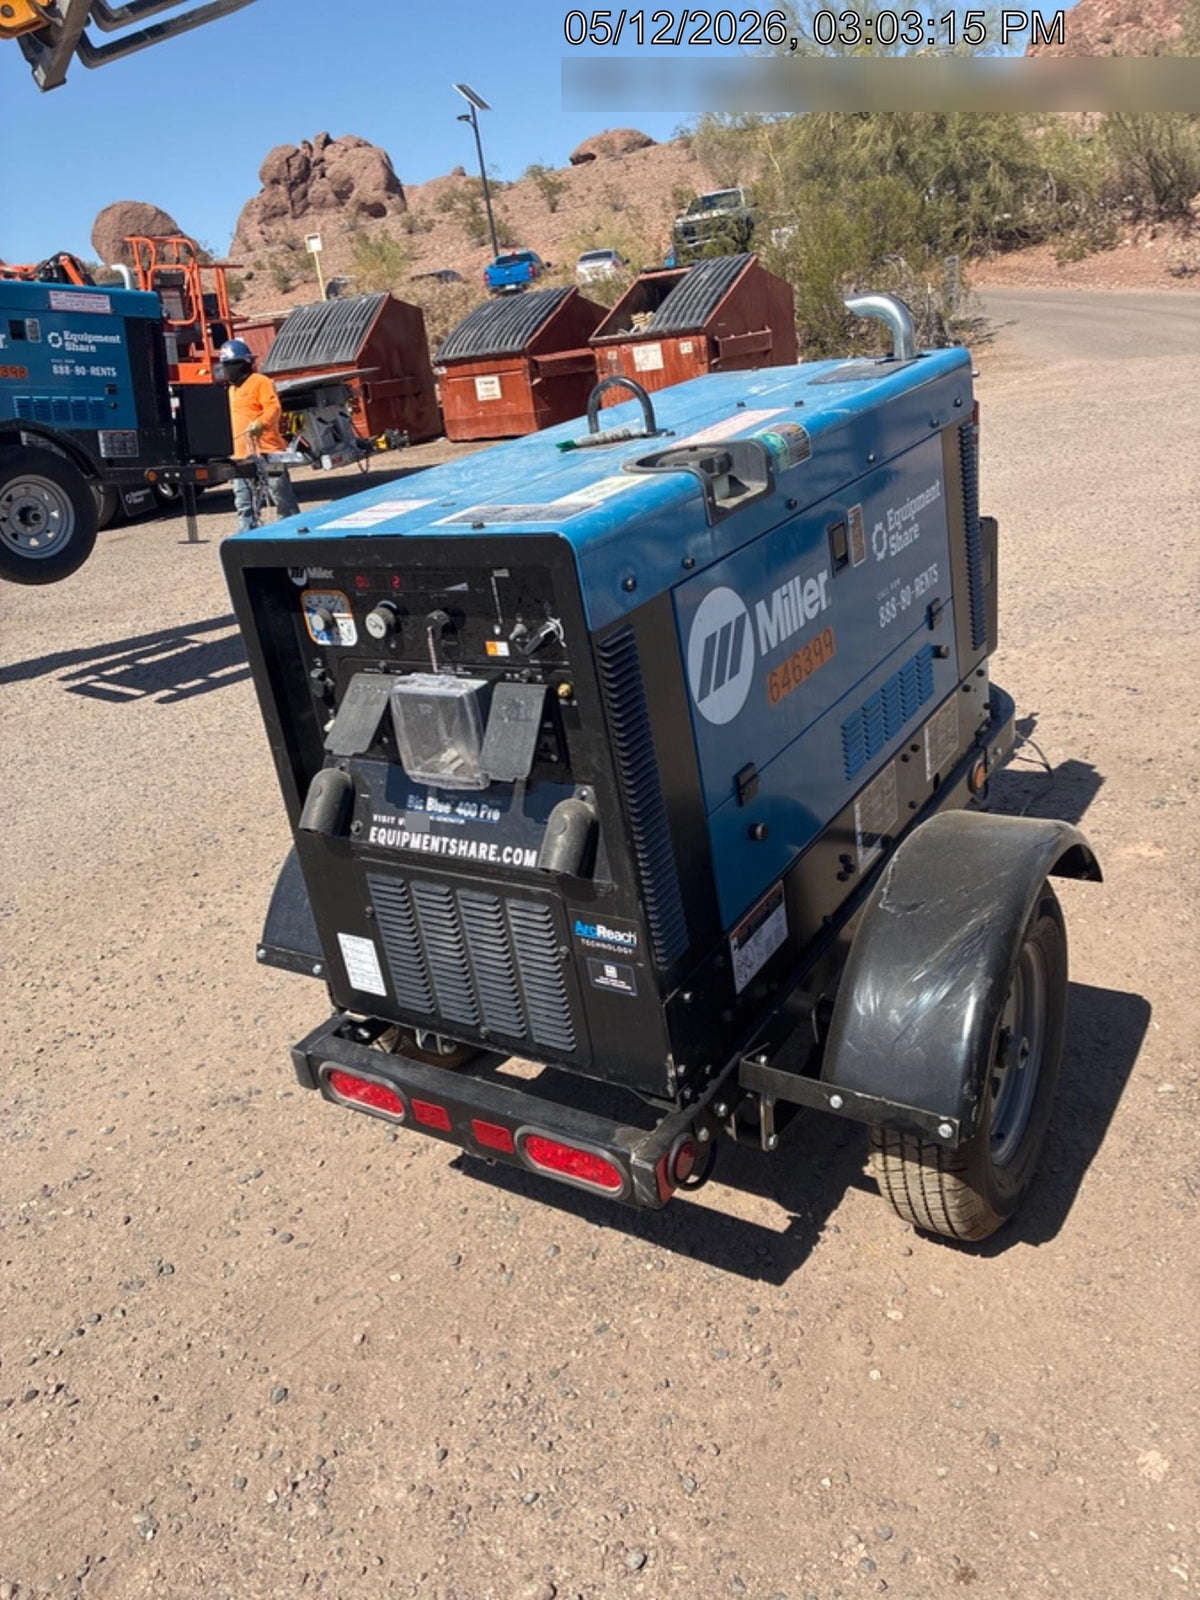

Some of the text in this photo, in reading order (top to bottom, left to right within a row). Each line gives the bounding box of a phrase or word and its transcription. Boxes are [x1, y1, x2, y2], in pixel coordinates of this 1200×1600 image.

[63, 330, 121, 344] Equipment
[64, 341, 97, 353] Share
[886, 479, 941, 532] Equipment
[889, 523, 920, 557] Share
[755, 569, 829, 656] Miller
[768, 627, 835, 704] 646399
[426, 796, 452, 814] Blue
[456, 801, 478, 818] 400
[368, 826, 539, 869] EQUIPMENTSHARE.COM
[575, 919, 638, 946] ArcReach
